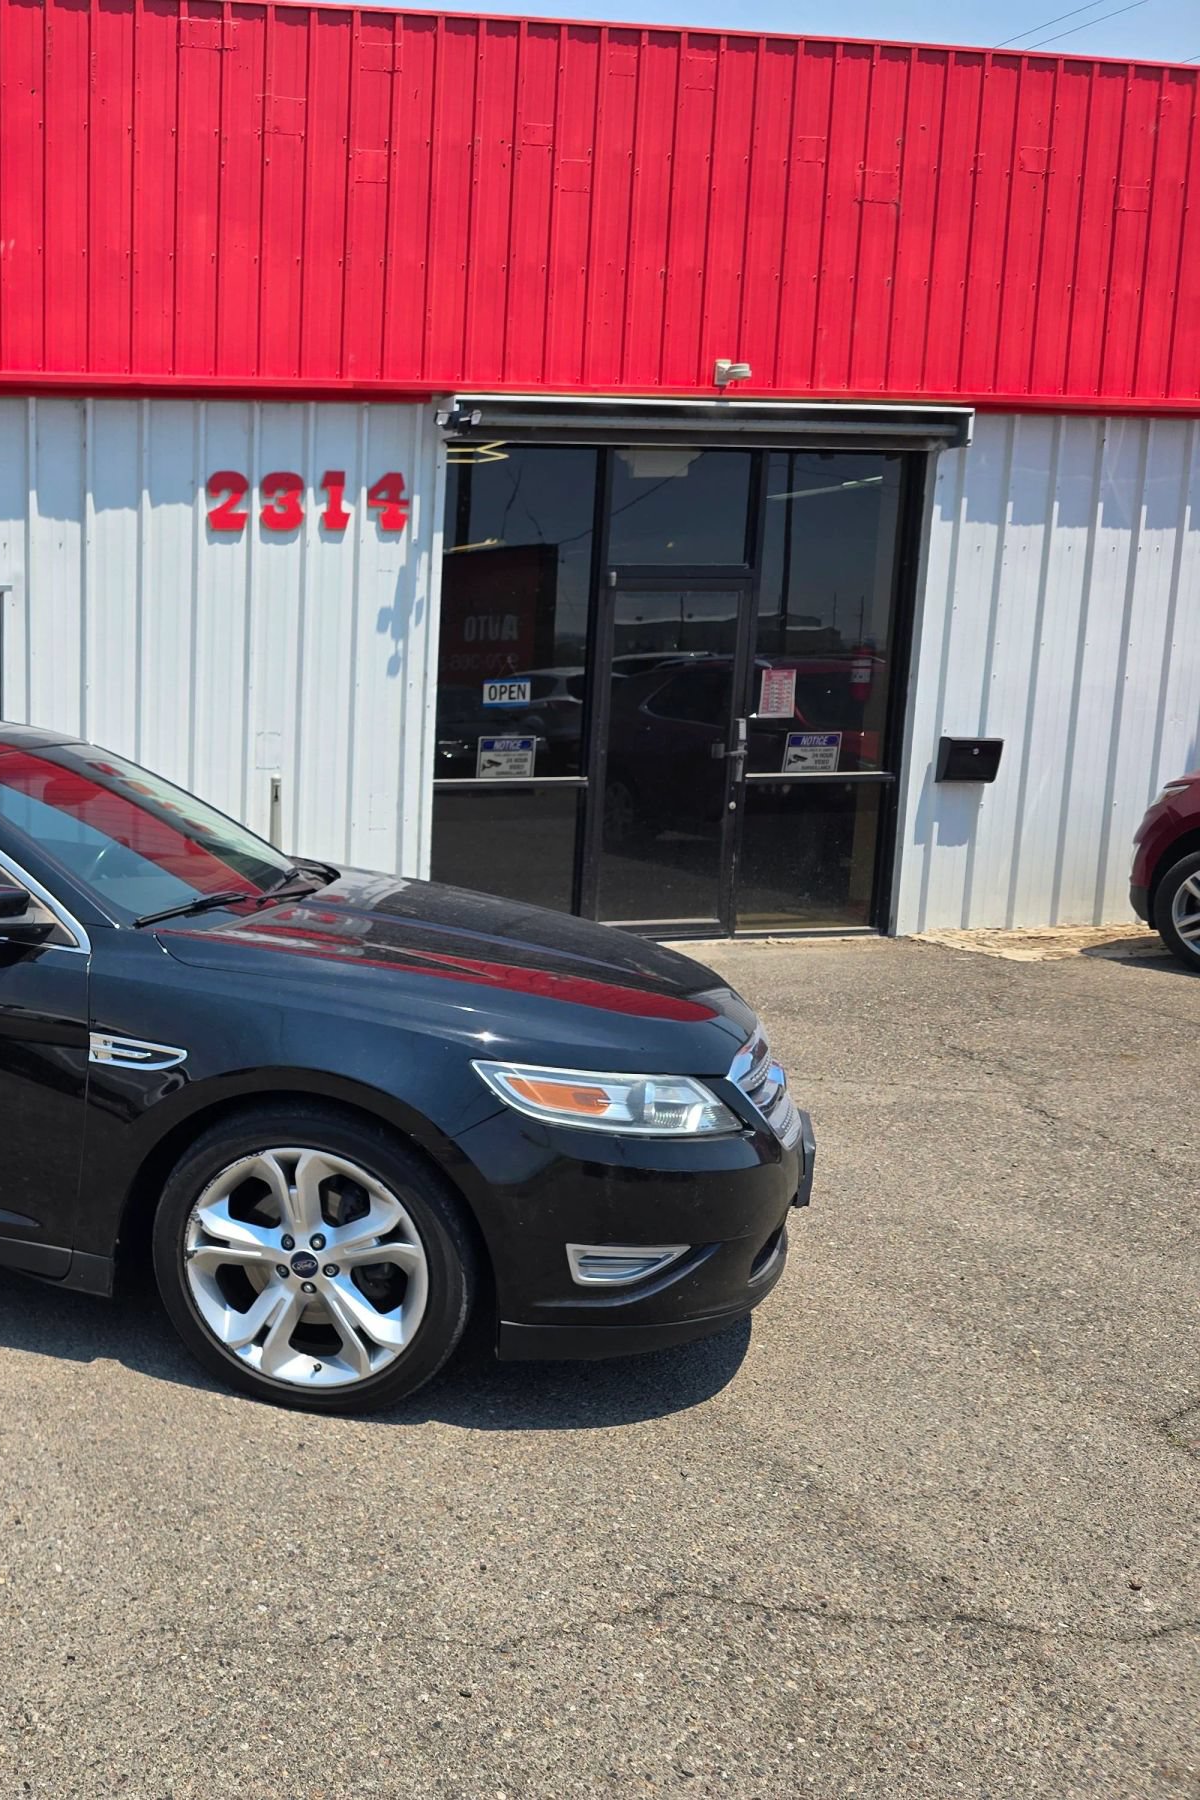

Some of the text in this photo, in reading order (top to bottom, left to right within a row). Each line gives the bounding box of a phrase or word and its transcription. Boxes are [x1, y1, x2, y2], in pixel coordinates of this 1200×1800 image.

[207, 470, 410, 532] 2314
[488, 683, 528, 701] OPEN
[493, 739, 523, 750] NOTICE
[800, 735, 829, 746] NOTICE
